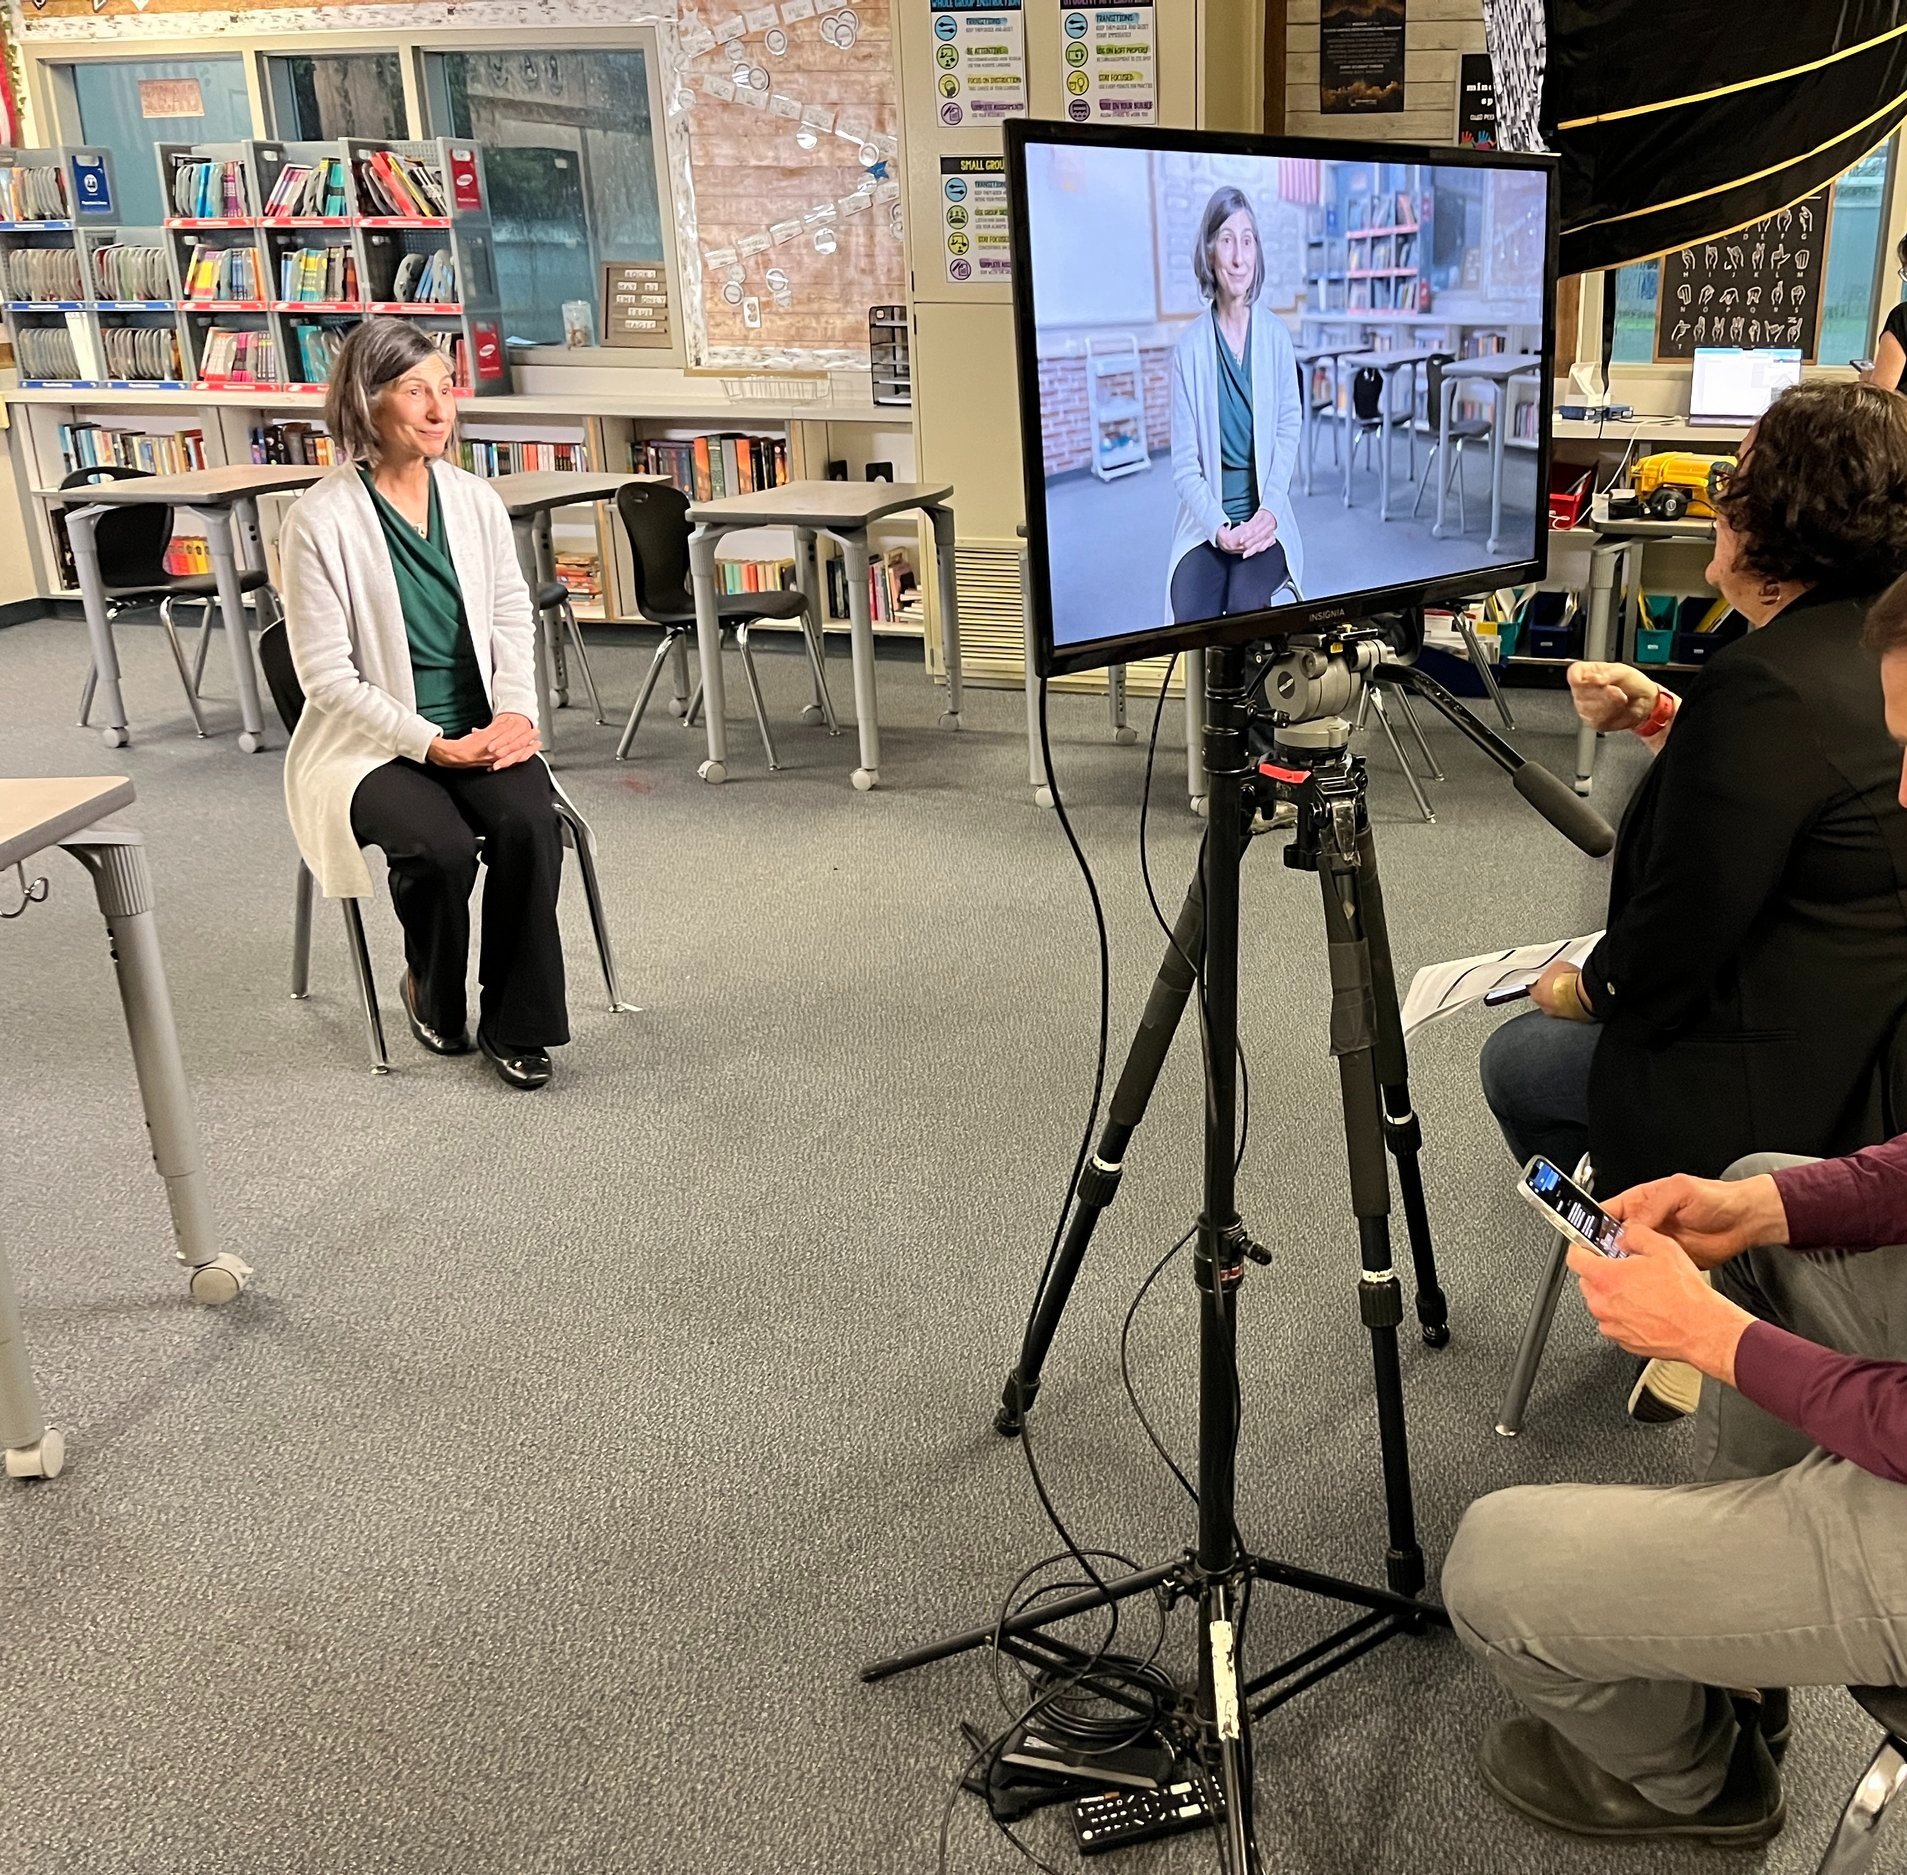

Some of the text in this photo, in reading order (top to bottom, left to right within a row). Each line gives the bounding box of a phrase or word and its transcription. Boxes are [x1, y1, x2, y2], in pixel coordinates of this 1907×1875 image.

[960, 159, 1004, 170] SMALL GROU
[1309, 608, 1345, 622] INSIGNIA
